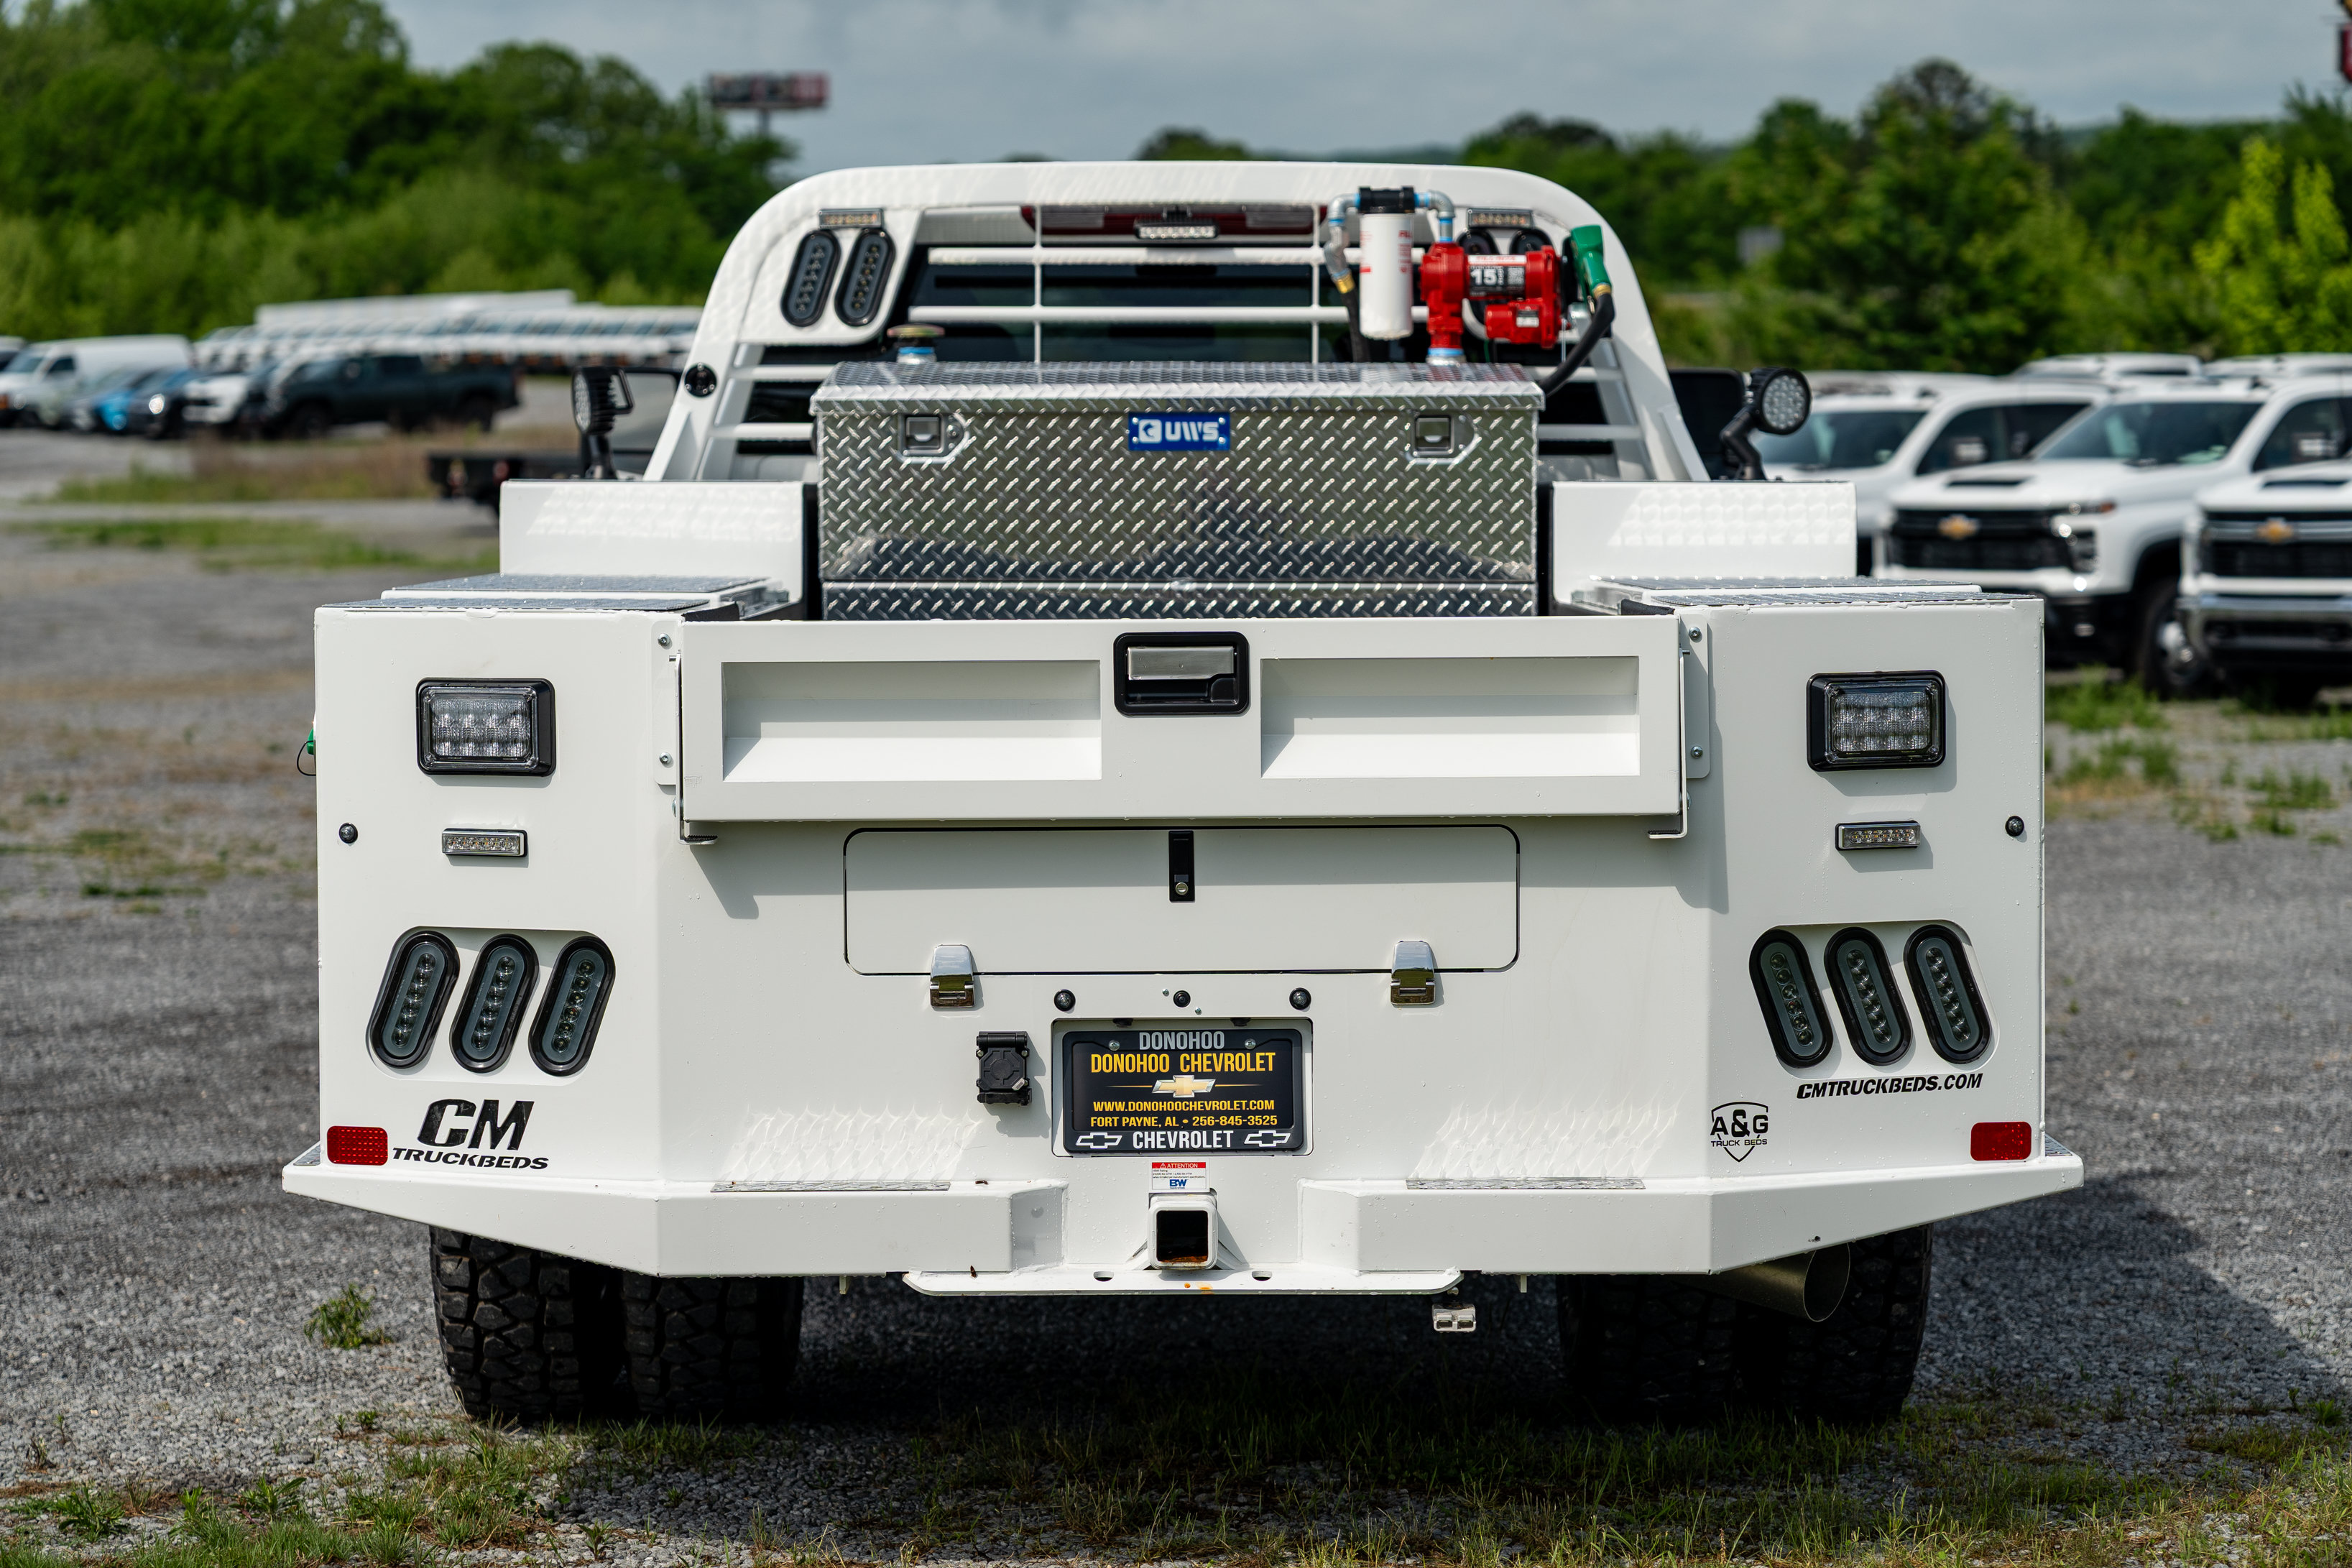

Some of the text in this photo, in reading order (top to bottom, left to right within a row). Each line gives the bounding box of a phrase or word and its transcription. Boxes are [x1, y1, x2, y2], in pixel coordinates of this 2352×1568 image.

[1470, 269, 1497, 285] 15
[1165, 421, 1219, 442] UWS
[1139, 1031, 1225, 1050] DONOHOO
[1091, 1052, 1276, 1073] DONOHOO CHEVROLET
[1797, 1073, 1983, 1099] CMTRUCKBEDS.COM
[1093, 1100, 1275, 1112] WWW.DONOHOOCHEVROLET.COM
[418, 1099, 535, 1150] CM
[1090, 1115, 1278, 1127] FORT PAYNE, AL 256-845-3525
[1710, 1110, 1768, 1138] A&G
[1133, 1130, 1234, 1149] CHEVROLET
[392, 1148, 549, 1170] TRUCKBEDS
